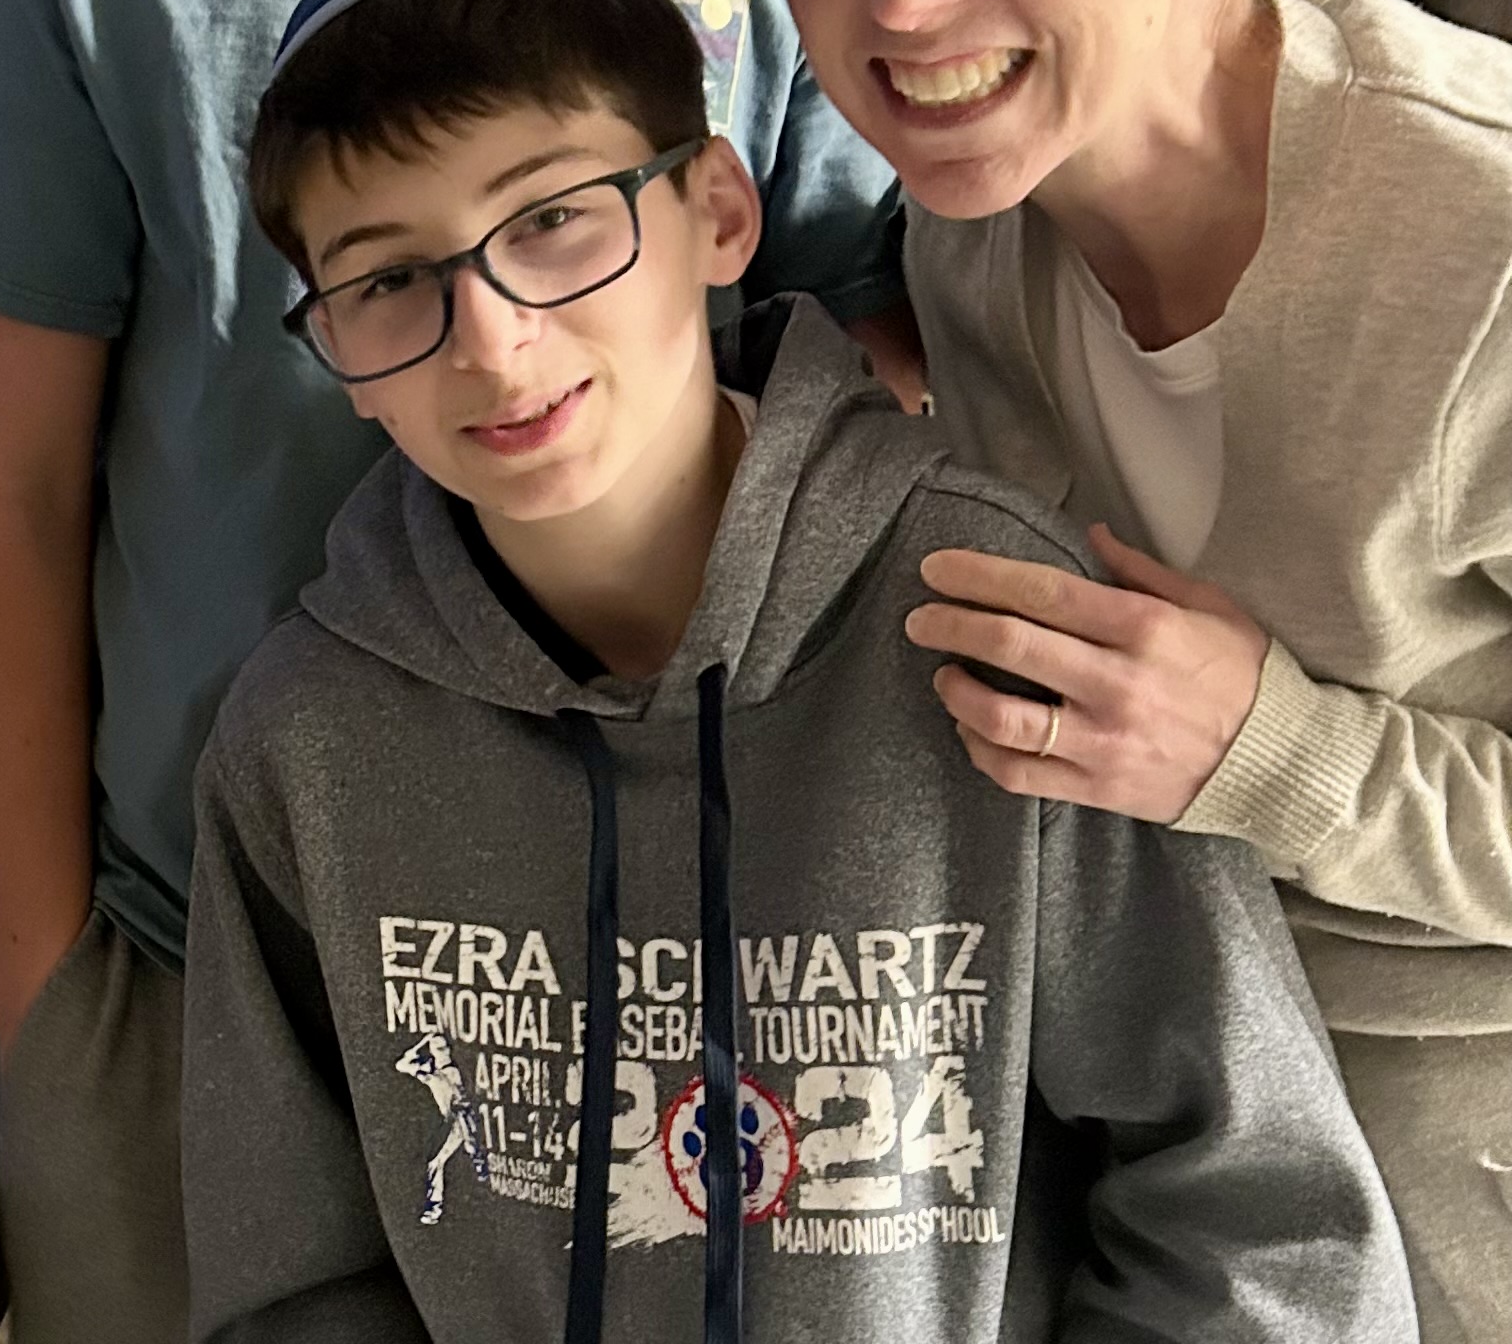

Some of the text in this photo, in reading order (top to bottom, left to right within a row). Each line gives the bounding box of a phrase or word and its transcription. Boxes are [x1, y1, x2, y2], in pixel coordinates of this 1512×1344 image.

[379, 916, 562, 995] EZRA
[385, 980, 988, 1065] MEMORIAL BSEBA TOURNAMENT
[479, 1103, 565, 1161] 11-14
[772, 1213, 917, 1256] MAIMONIDES
